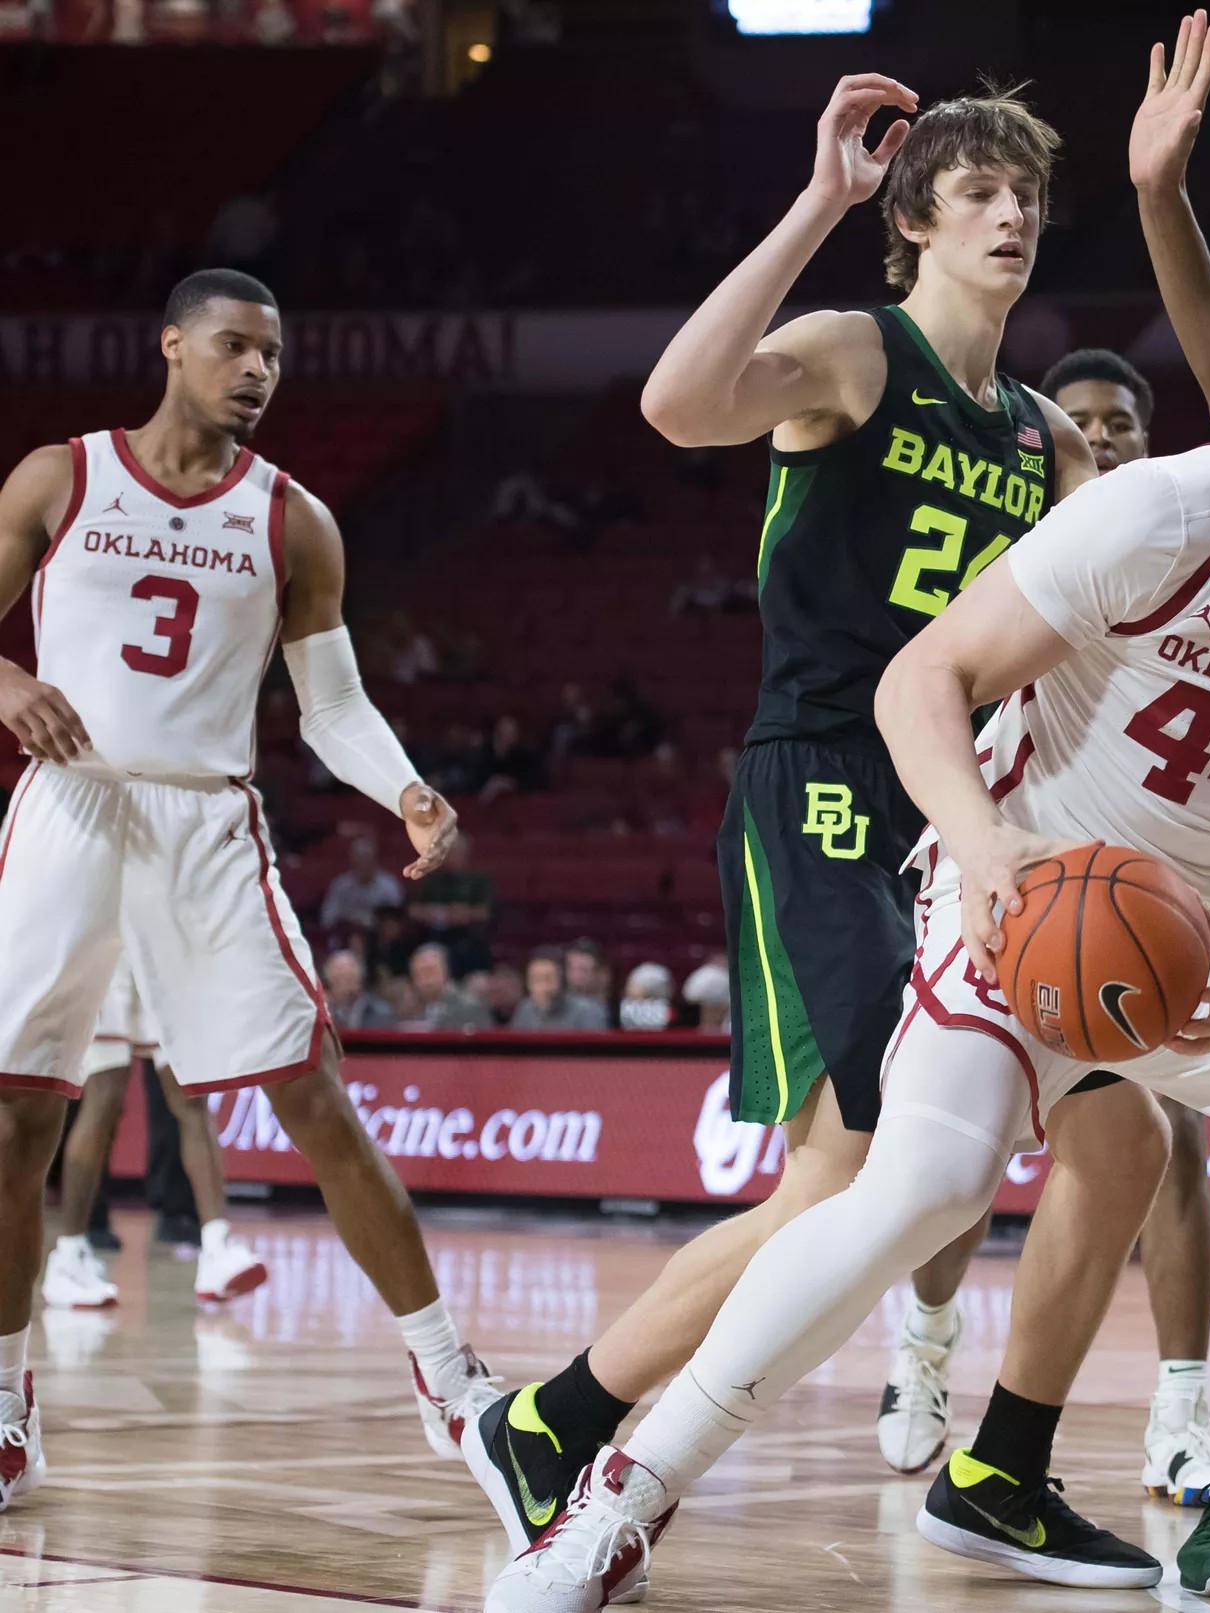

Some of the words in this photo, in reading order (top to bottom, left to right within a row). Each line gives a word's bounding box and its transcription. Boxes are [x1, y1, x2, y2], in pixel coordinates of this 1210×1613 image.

[89, 314, 497, 381] OKHOMA
[880, 426, 1045, 524] BAYLOR
[84, 530, 258, 577] OKLAHOMA
[120, 574, 200, 678] 3
[802, 782, 870, 860] BU
